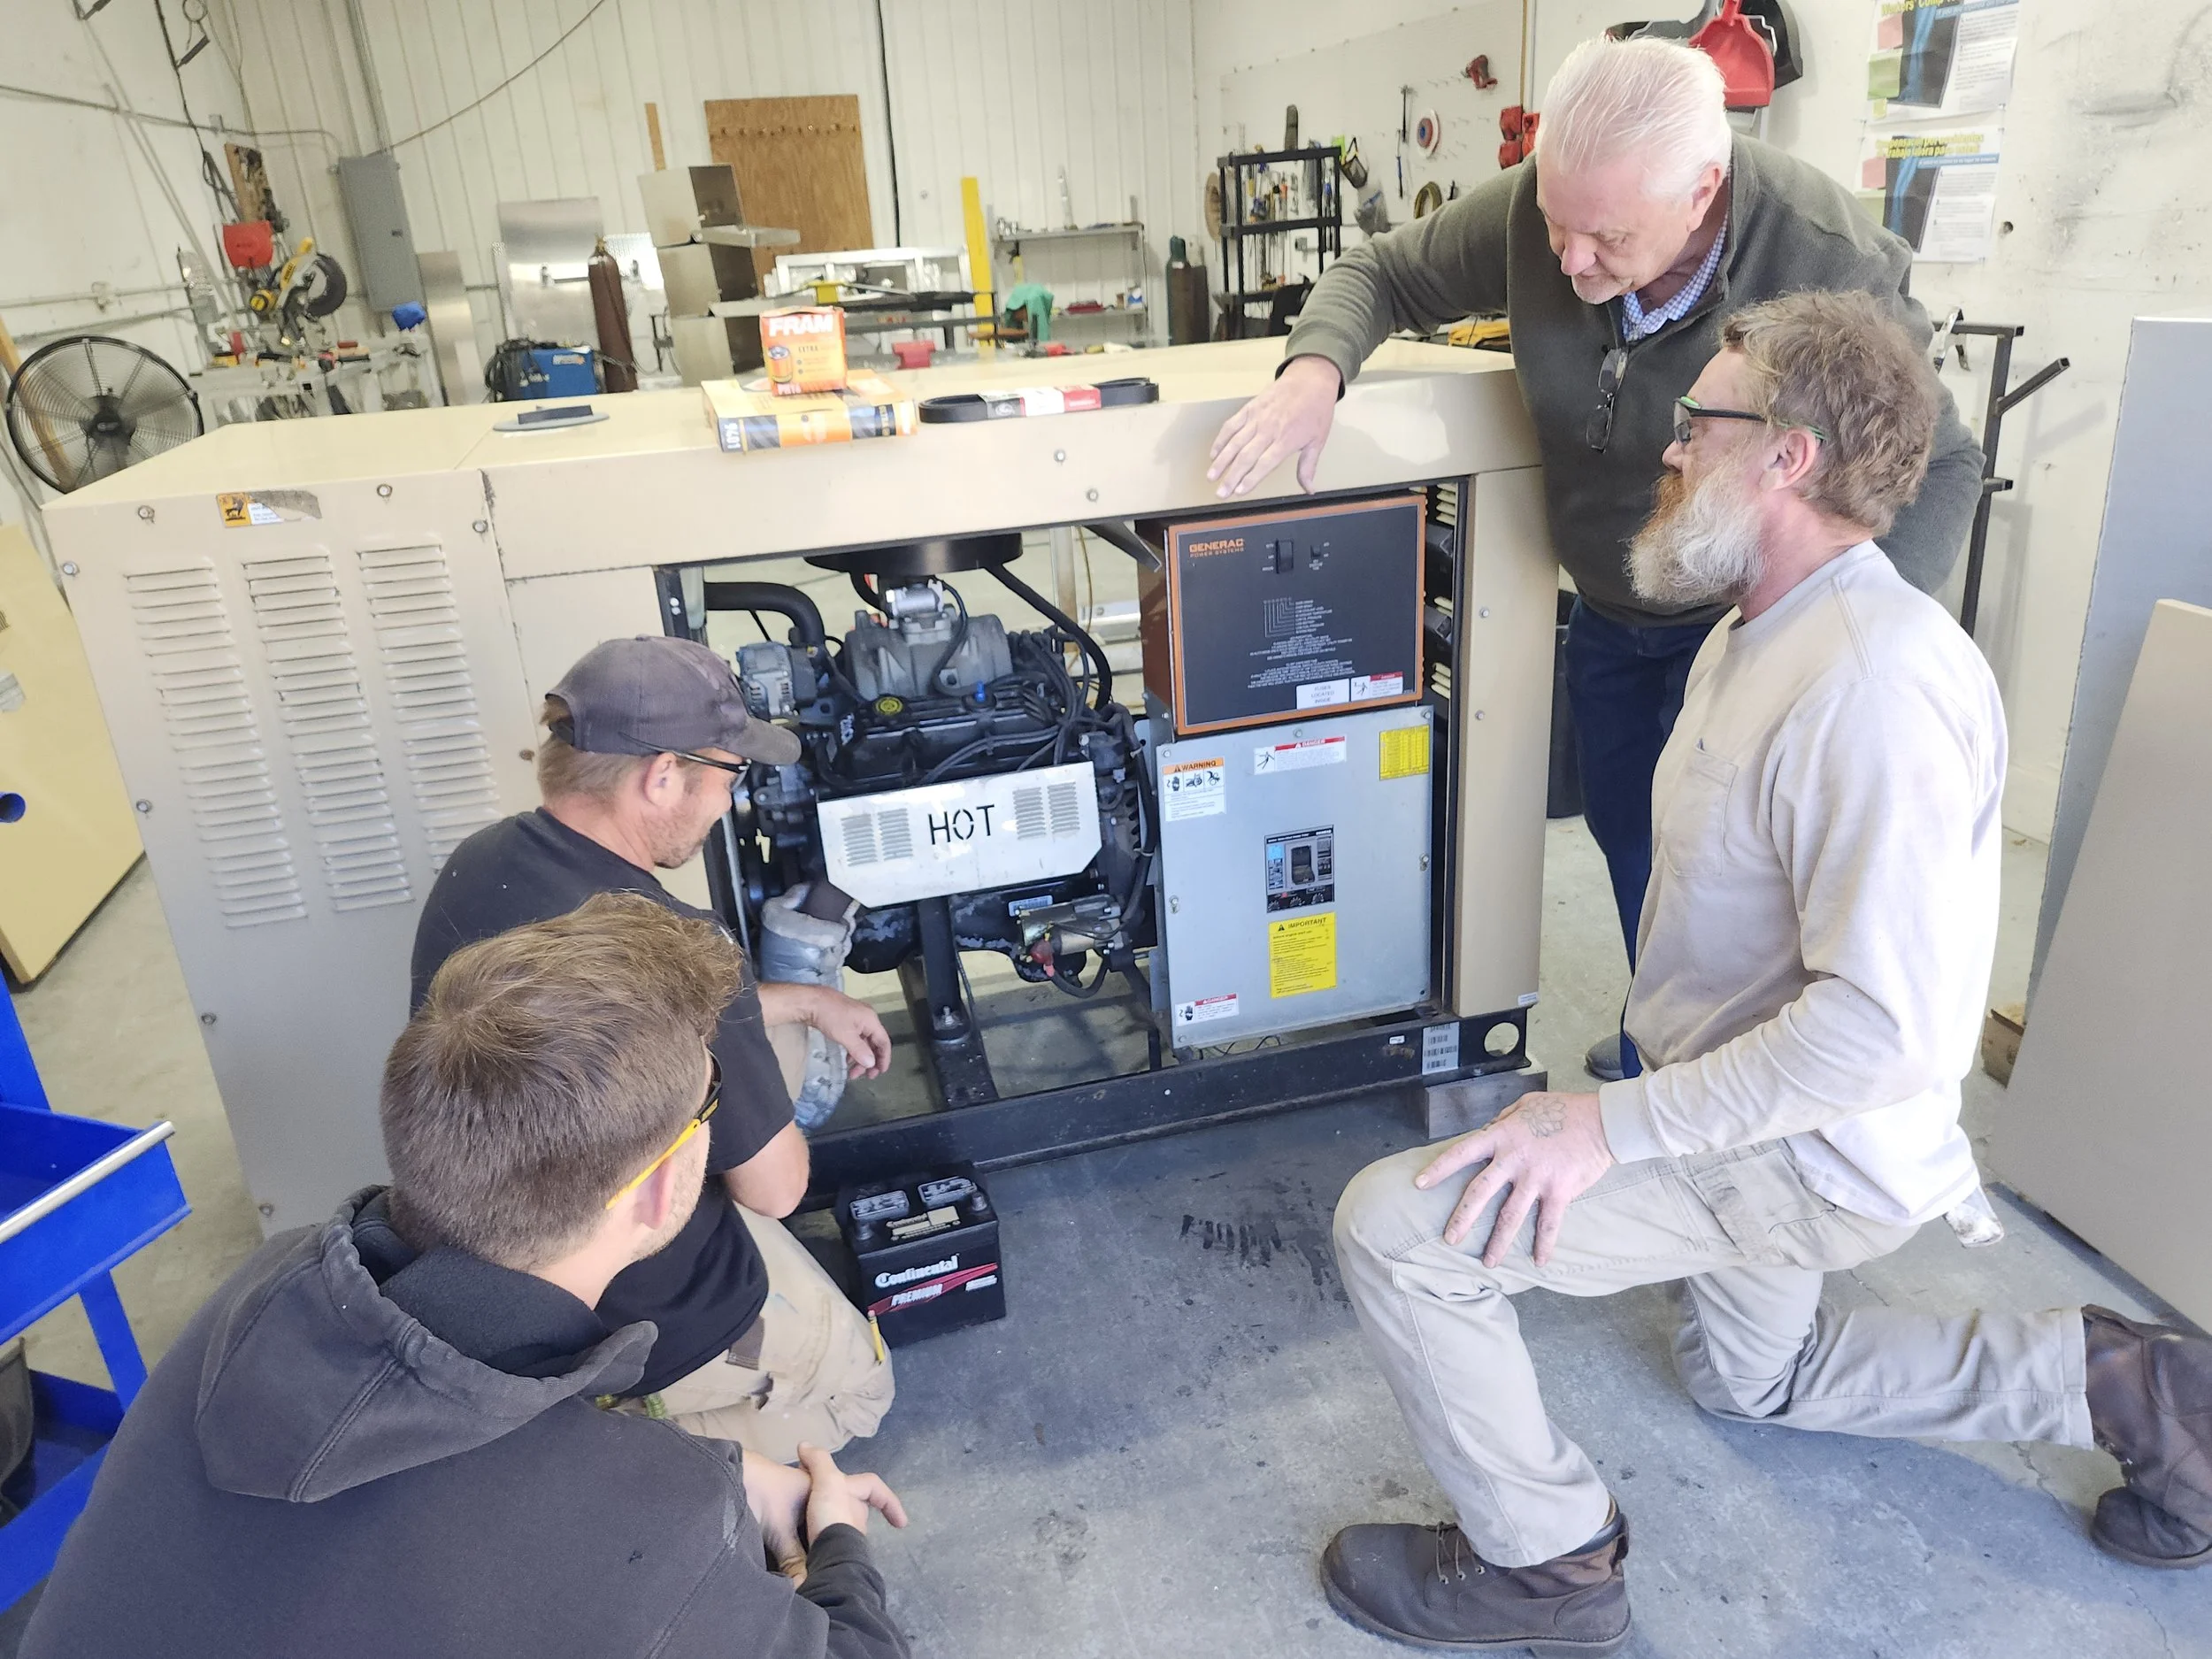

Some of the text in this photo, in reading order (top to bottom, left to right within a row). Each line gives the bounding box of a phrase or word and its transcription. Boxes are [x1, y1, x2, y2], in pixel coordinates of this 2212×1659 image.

[769, 314, 833, 337] FRAM
[1189, 538, 1244, 553] GENERAC
[1302, 738, 1325, 748] DANGER
[1181, 760, 1217, 772] WARNING
[927, 803, 995, 845] HOT
[1287, 917, 1326, 929] IMPORTANT
[875, 1255, 958, 1287] Continental
